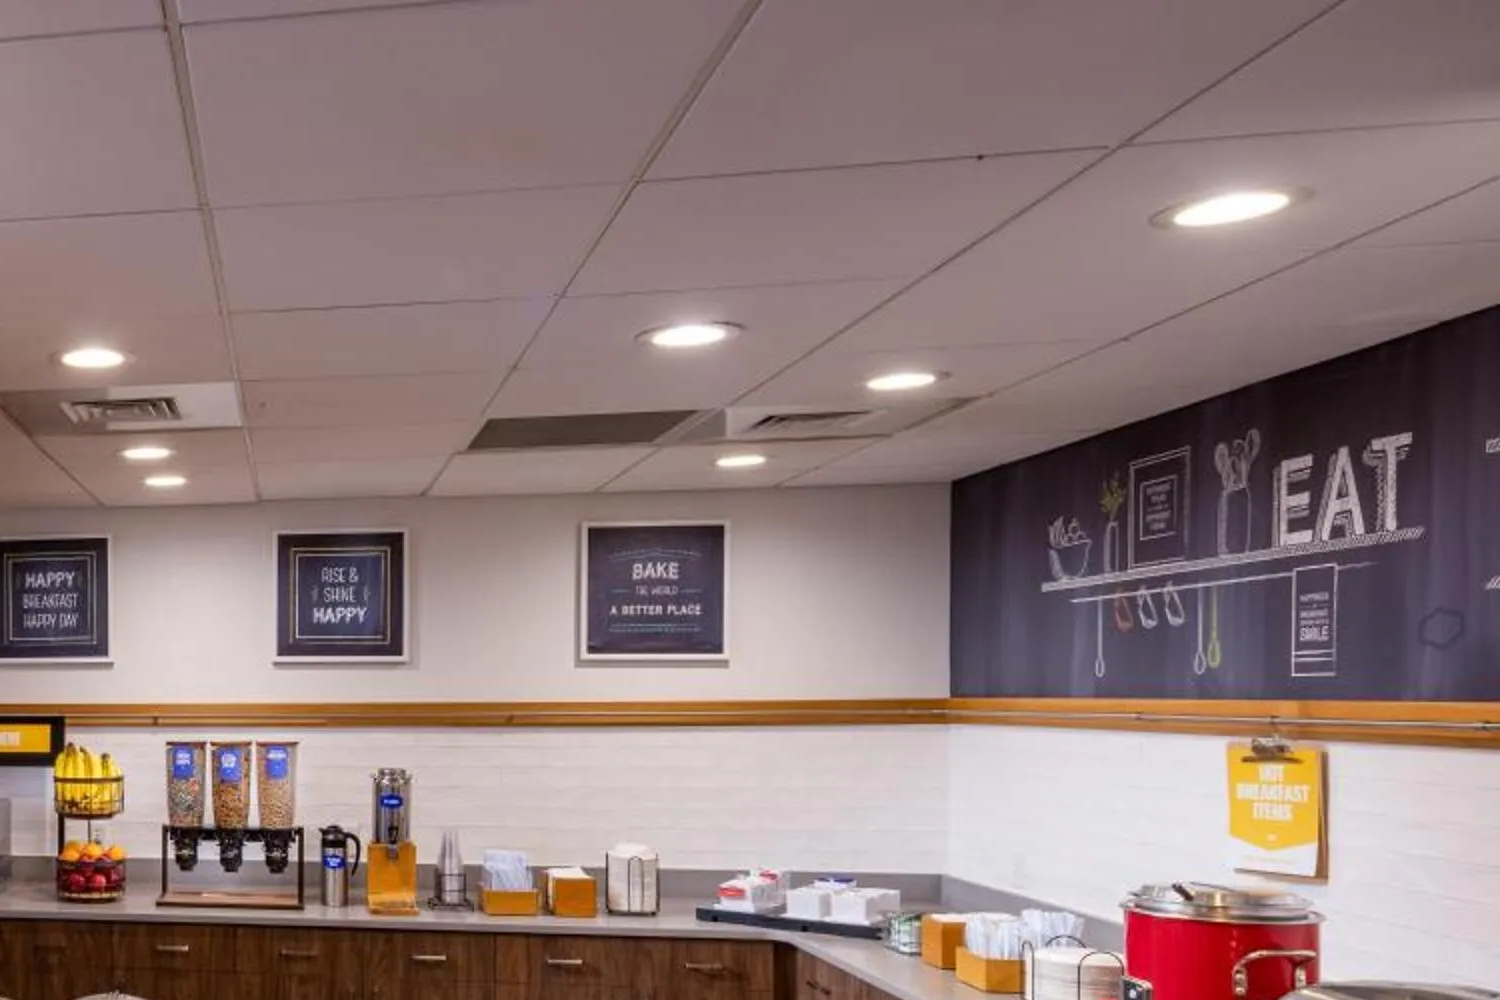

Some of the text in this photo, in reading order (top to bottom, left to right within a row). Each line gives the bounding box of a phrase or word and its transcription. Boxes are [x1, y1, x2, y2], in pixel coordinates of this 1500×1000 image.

[1273, 432, 1413, 546] EAT
[25, 571, 75, 588] HAPPY
[348, 567, 359, 583] &
[632, 562, 680, 580] BAKE
[23, 593, 79, 609] BREAKFAST
[323, 586, 357, 603] SHINE
[313, 606, 369, 624] HAPPY
[610, 603, 703, 616] A BETTER PLACE
[23, 613, 57, 629] HAPPY
[1236, 783, 1311, 803] BREAKFAST
